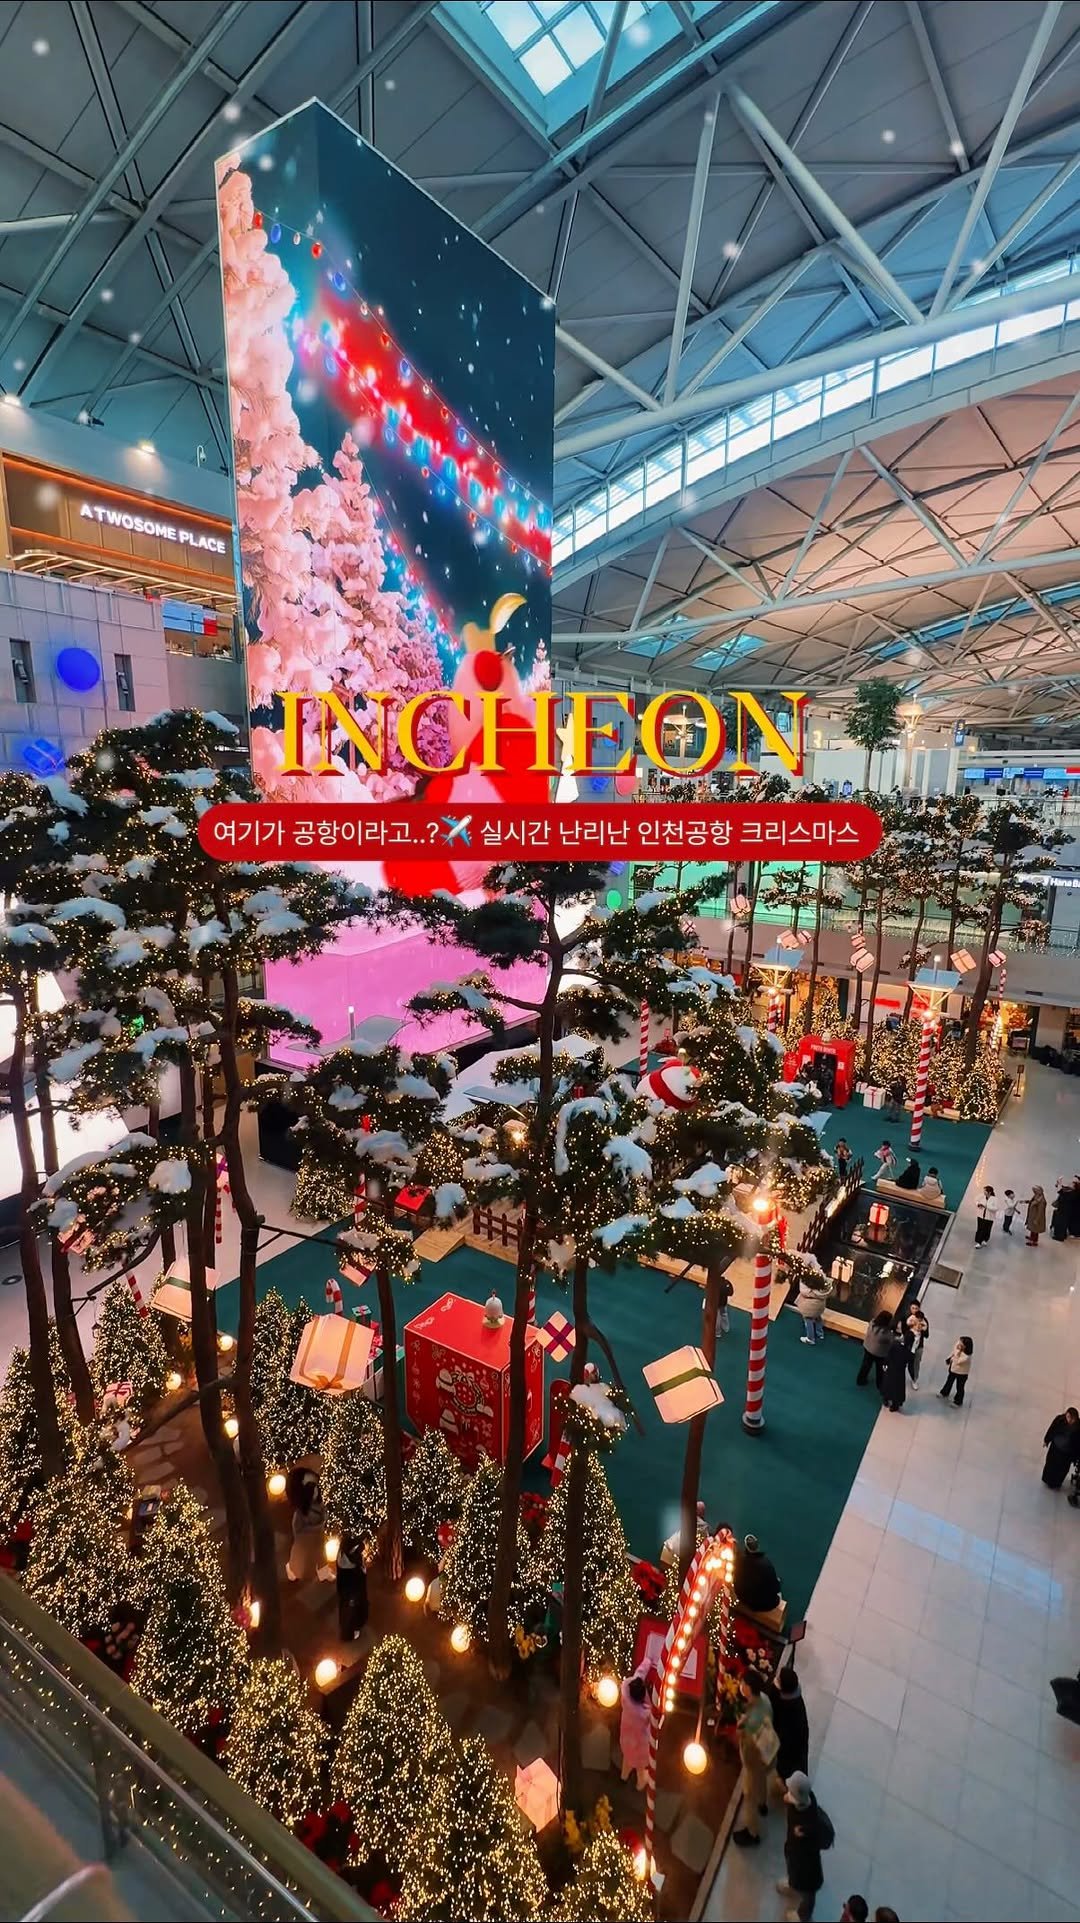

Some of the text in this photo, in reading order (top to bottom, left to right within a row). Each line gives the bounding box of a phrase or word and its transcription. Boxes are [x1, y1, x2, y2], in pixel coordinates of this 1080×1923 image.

[80, 503, 226, 553] A TWOSOME PLACE
